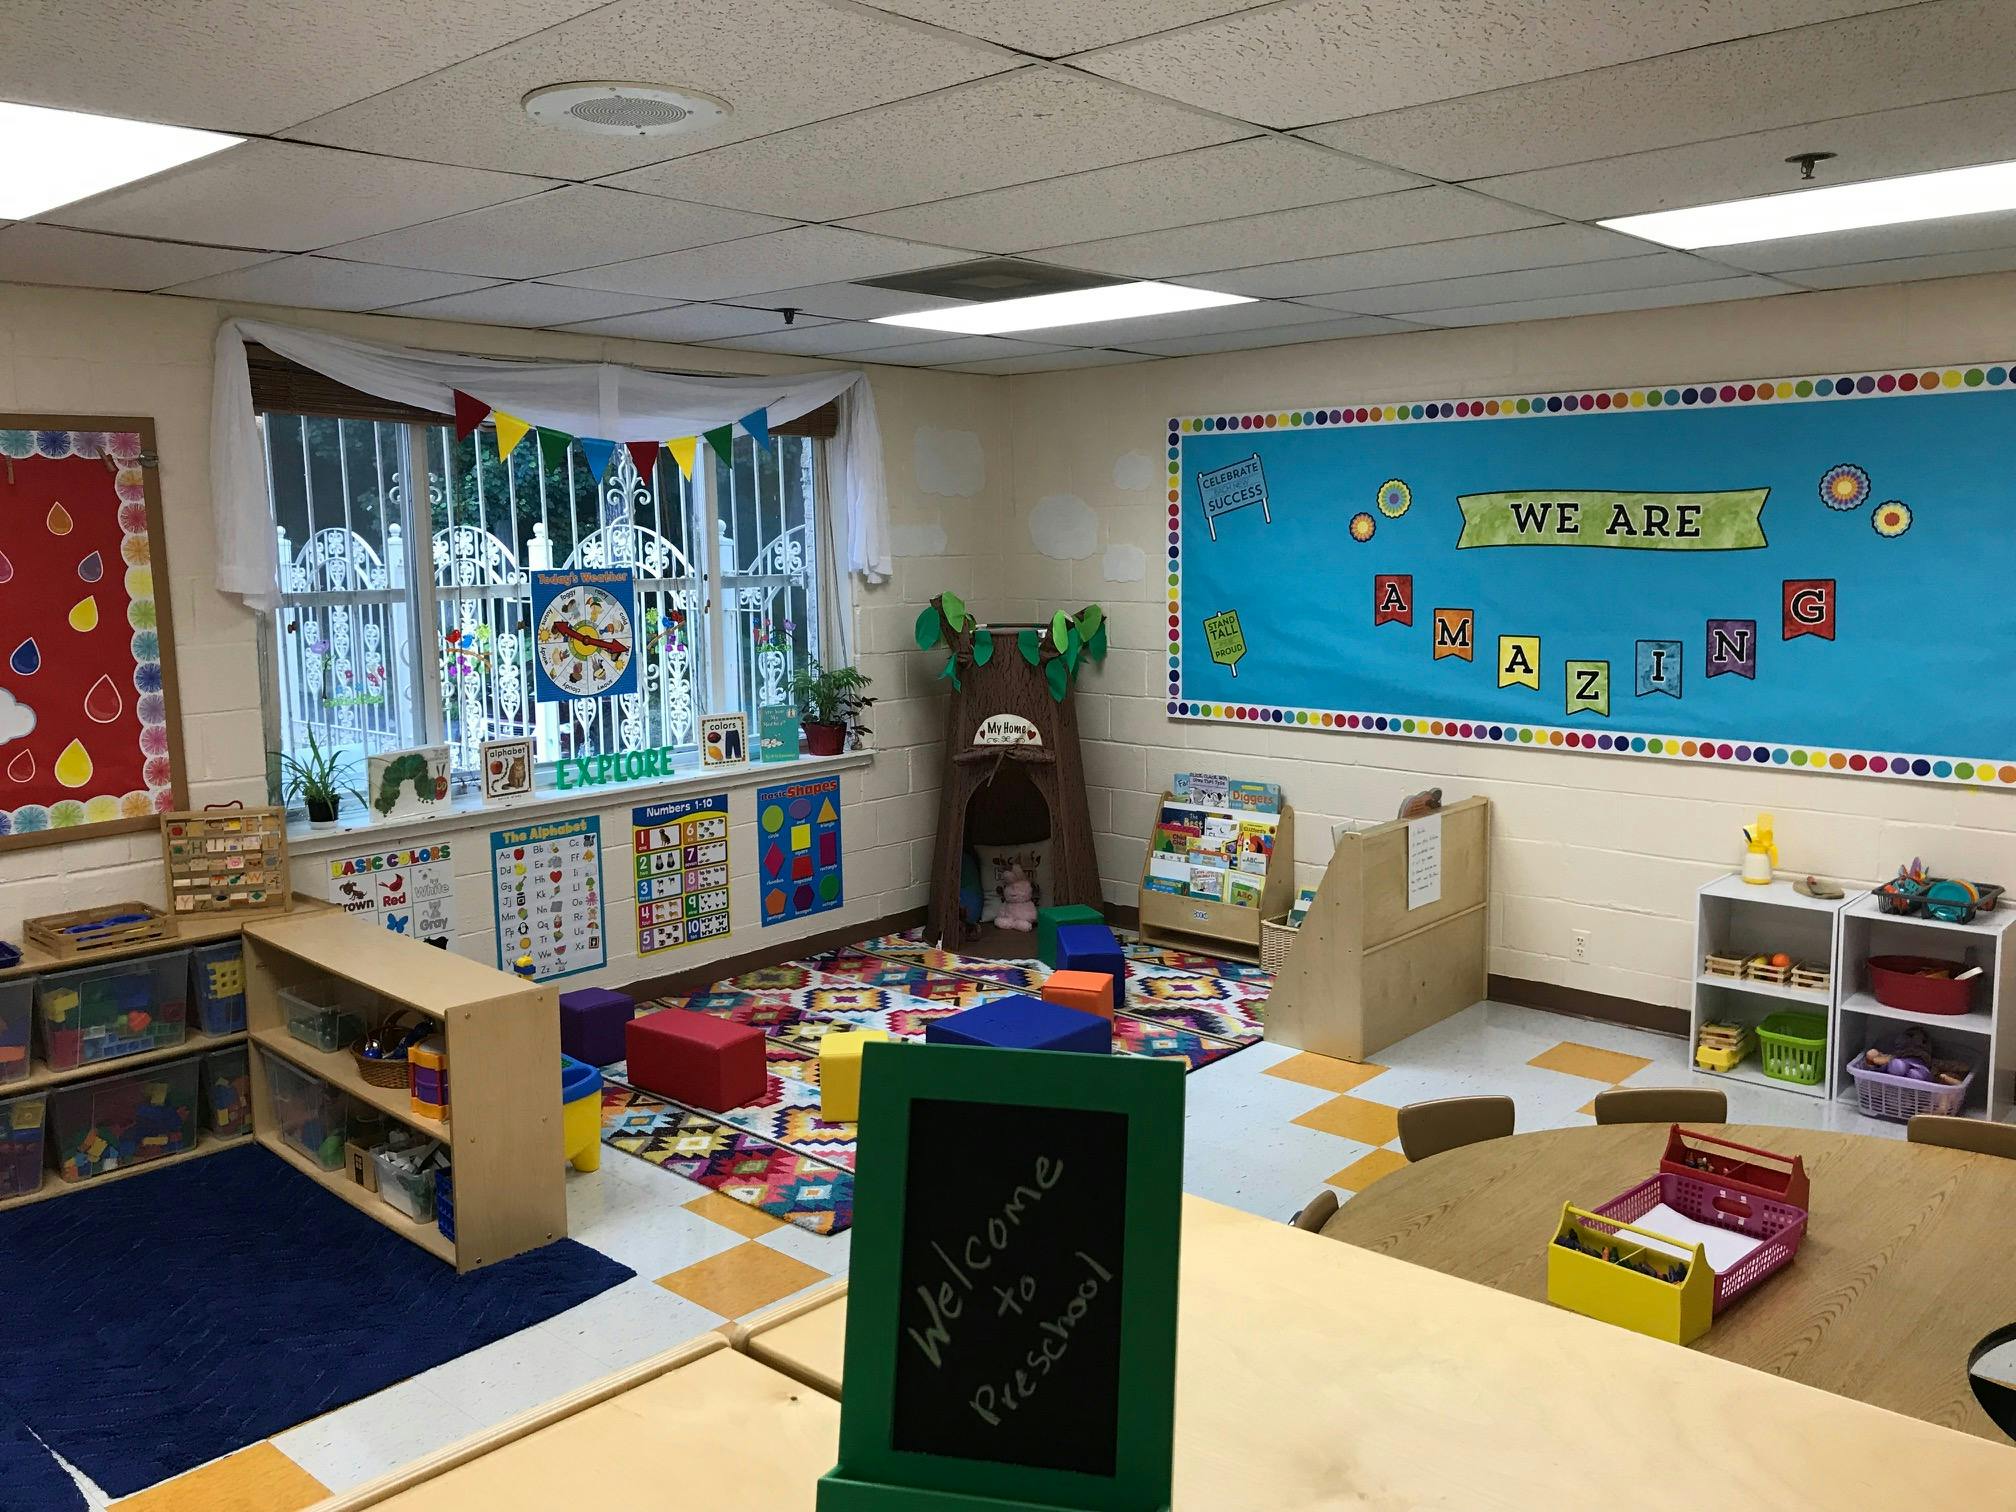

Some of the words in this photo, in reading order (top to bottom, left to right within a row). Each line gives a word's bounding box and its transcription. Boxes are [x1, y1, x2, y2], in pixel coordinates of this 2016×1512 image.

[1202, 461, 1259, 489] CELEBRATE
[1208, 484, 1263, 512] SUCCESS
[1510, 502, 1580, 536] WE
[1605, 503, 1702, 539] ARE
[537, 572, 579, 586] Today's
[580, 571, 628, 583] Weather
[1207, 615, 1235, 632] STAND
[1210, 624, 1239, 641] TALL
[1215, 643, 1243, 659] PROUD
[709, 721, 737, 731] colors
[986, 721, 1002, 736] My
[1003, 721, 1027, 735] Home
[489, 746, 526, 761] alphabet
[556, 745, 675, 790] EXPLORE
[786, 780, 838, 798] Shapes
[1232, 790, 1273, 805] Diggers
[646, 802, 691, 818] Numbers
[694, 798, 713, 810] 1-10
[502, 830, 528, 844] The
[529, 819, 588, 840] Alphabet
[686, 823, 695, 836] 6
[532, 845, 544, 855] Bb
[568, 839, 580, 848] Cc
[686, 847, 695, 861] 7
[331, 855, 384, 878] BASIC
[386, 844, 451, 868] COLORS
[500, 865, 512, 876] Dd
[534, 860, 545, 870] Ee
[570, 853, 580, 862] Ff
[639, 856, 648, 870] 2
[500, 882, 512, 893] Gg
[534, 876, 546, 885] Hh
[688, 872, 696, 885] 8
[414, 882, 450, 899] White
[640, 881, 649, 895] 3
[335, 899, 375, 913] rown
[382, 892, 407, 908] Red
[502, 897, 512, 908] Jj
[536, 890, 547, 899] Kk
[688, 895, 697, 909] 9
[501, 912, 516, 922] Mm
[536, 905, 548, 915] Nn
[572, 898, 583, 907] Oo
[641, 906, 650, 919] 4
[419, 917, 448, 932] Gray
[505, 927, 515, 938] Pp
[537, 921, 550, 931] Qq
[573, 912, 584, 921] Rr
[688, 920, 700, 934] 10
[642, 930, 651, 945] 5
[505, 943, 516, 952] Ss
[537, 950, 553, 959] Ww
[575, 942, 585, 951] Xx
[541, 965, 551, 975] Zz
[908, 1155, 1064, 1369] Welcome
[993, 1275, 1036, 1317] to
[969, 1251, 1115, 1426] Preschool
